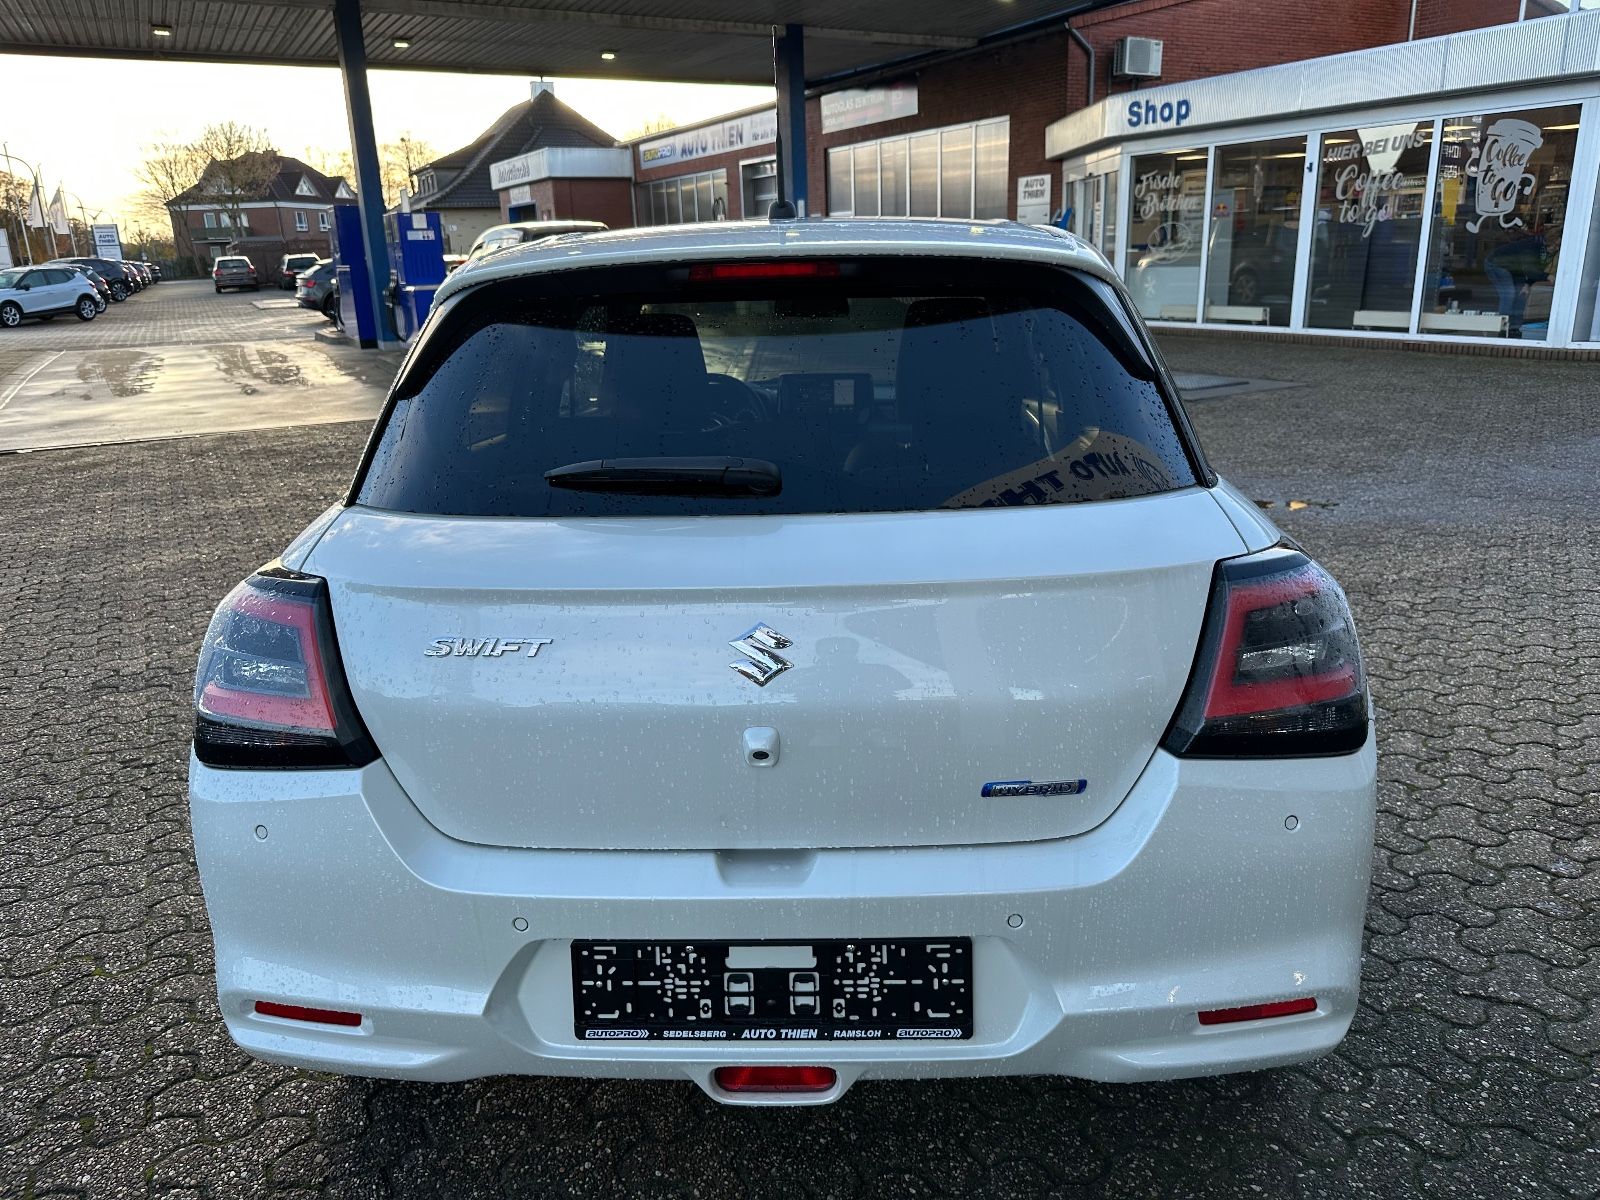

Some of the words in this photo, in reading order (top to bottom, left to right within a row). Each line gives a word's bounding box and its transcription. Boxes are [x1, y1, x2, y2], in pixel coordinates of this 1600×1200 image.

[1127, 99, 1190, 127] Shop
[681, 136, 708, 158] AUTO
[710, 122, 744, 152] THIEN
[1326, 143, 1360, 162] HIER
[1362, 137, 1390, 156] BEI
[1391, 131, 1427, 152] UNS
[1486, 138, 1526, 168] Coffee
[1024, 178, 1045, 189] AUTO
[1134, 169, 1181, 199] Frische
[1335, 164, 1404, 208] Coffee
[1480, 164, 1497, 185] to
[1023, 189, 1046, 200] THIEN
[1140, 191, 1198, 220] Brötchen
[1339, 200, 1360, 223] to
[423, 637, 553, 658] SWIFT
[990, 782, 1079, 797] HYBRID
[663, 1030, 726, 1038] SEDELSBERG
[741, 1029, 776, 1039] AUTO
[780, 1029, 818, 1039] THIEN
[833, 1030, 881, 1038] RAMSLOH
